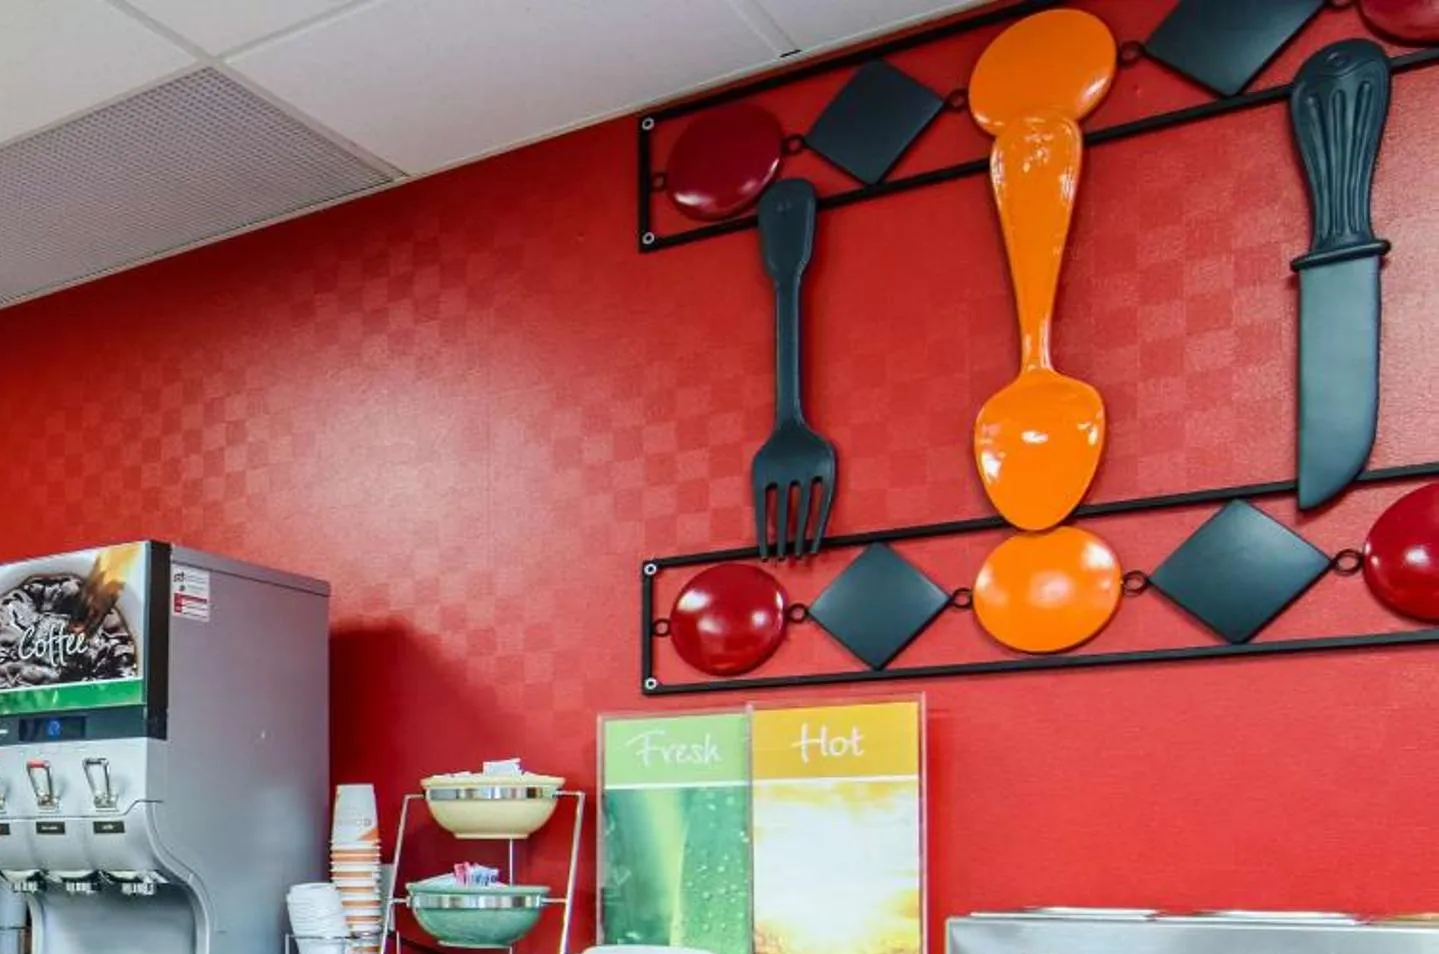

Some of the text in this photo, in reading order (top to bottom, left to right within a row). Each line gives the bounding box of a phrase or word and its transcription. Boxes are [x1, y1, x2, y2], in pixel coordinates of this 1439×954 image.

[18, 622, 89, 667] Coffee
[625, 729, 722, 767] Fresh
[791, 723, 864, 763] Hot
